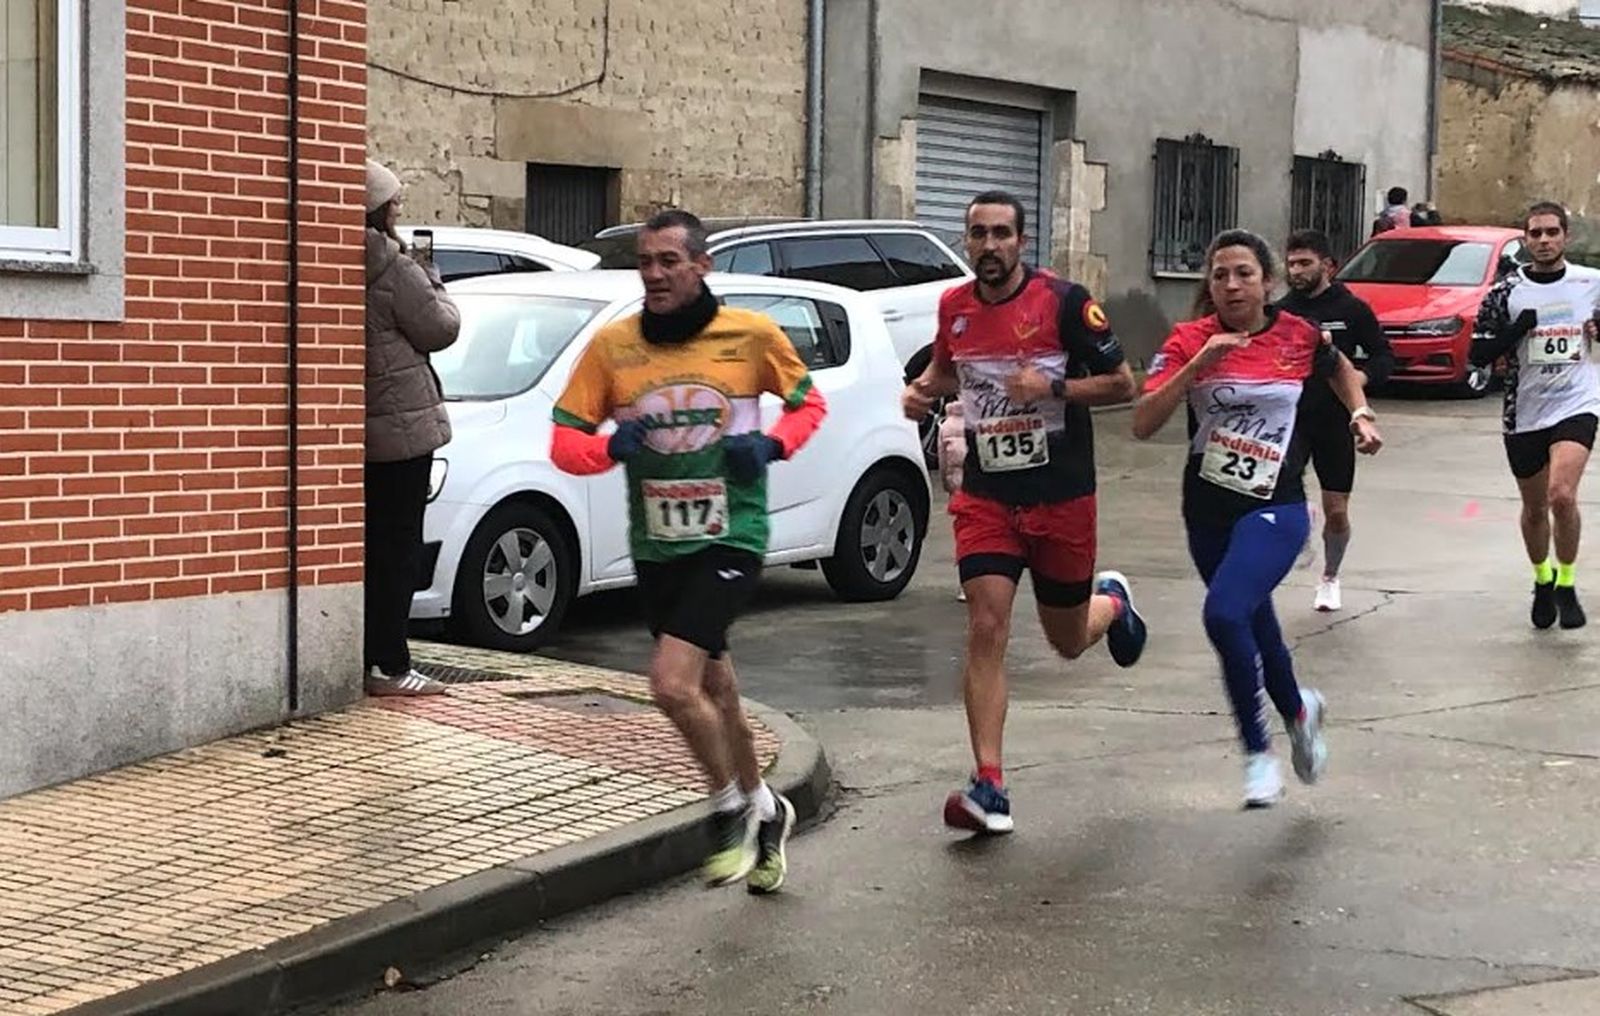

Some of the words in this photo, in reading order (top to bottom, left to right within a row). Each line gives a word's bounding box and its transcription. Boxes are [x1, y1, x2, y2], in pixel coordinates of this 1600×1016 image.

[1545, 337, 1568, 354] 60
[987, 432, 1034, 459] 135
[1221, 452, 1257, 481] 23
[659, 499, 712, 527] 117
